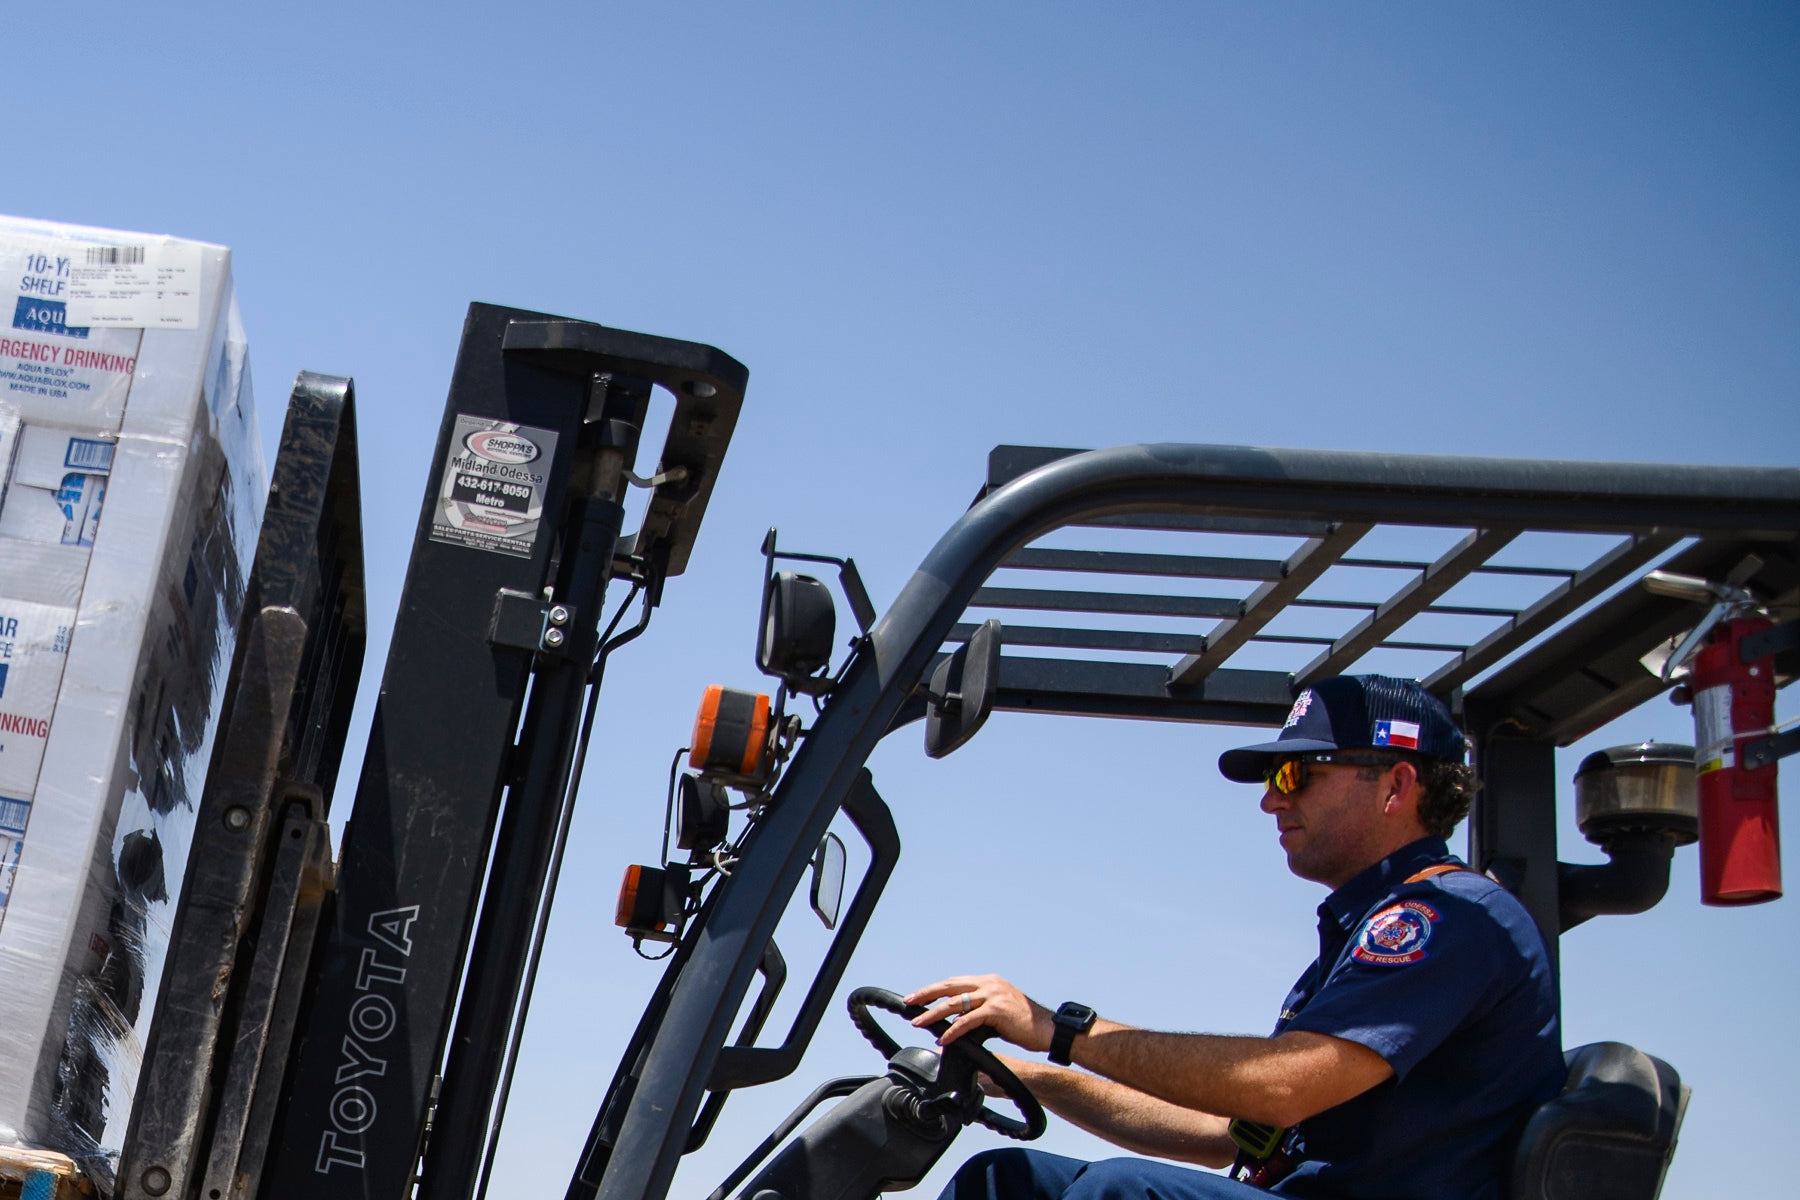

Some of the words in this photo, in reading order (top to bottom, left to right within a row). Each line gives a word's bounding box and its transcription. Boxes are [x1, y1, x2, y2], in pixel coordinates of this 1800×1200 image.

[23, 277, 66, 295] SHELF
[65, 349, 135, 375] DRINKING
[487, 438, 534, 454] SHOPPA'S
[451, 457, 498, 475] Midland
[500, 466, 543, 484] Odessa
[475, 493, 505, 507] Metro
[1375, 955, 1412, 964] RESCUE
[314, 904, 420, 1174] TOYOTA
